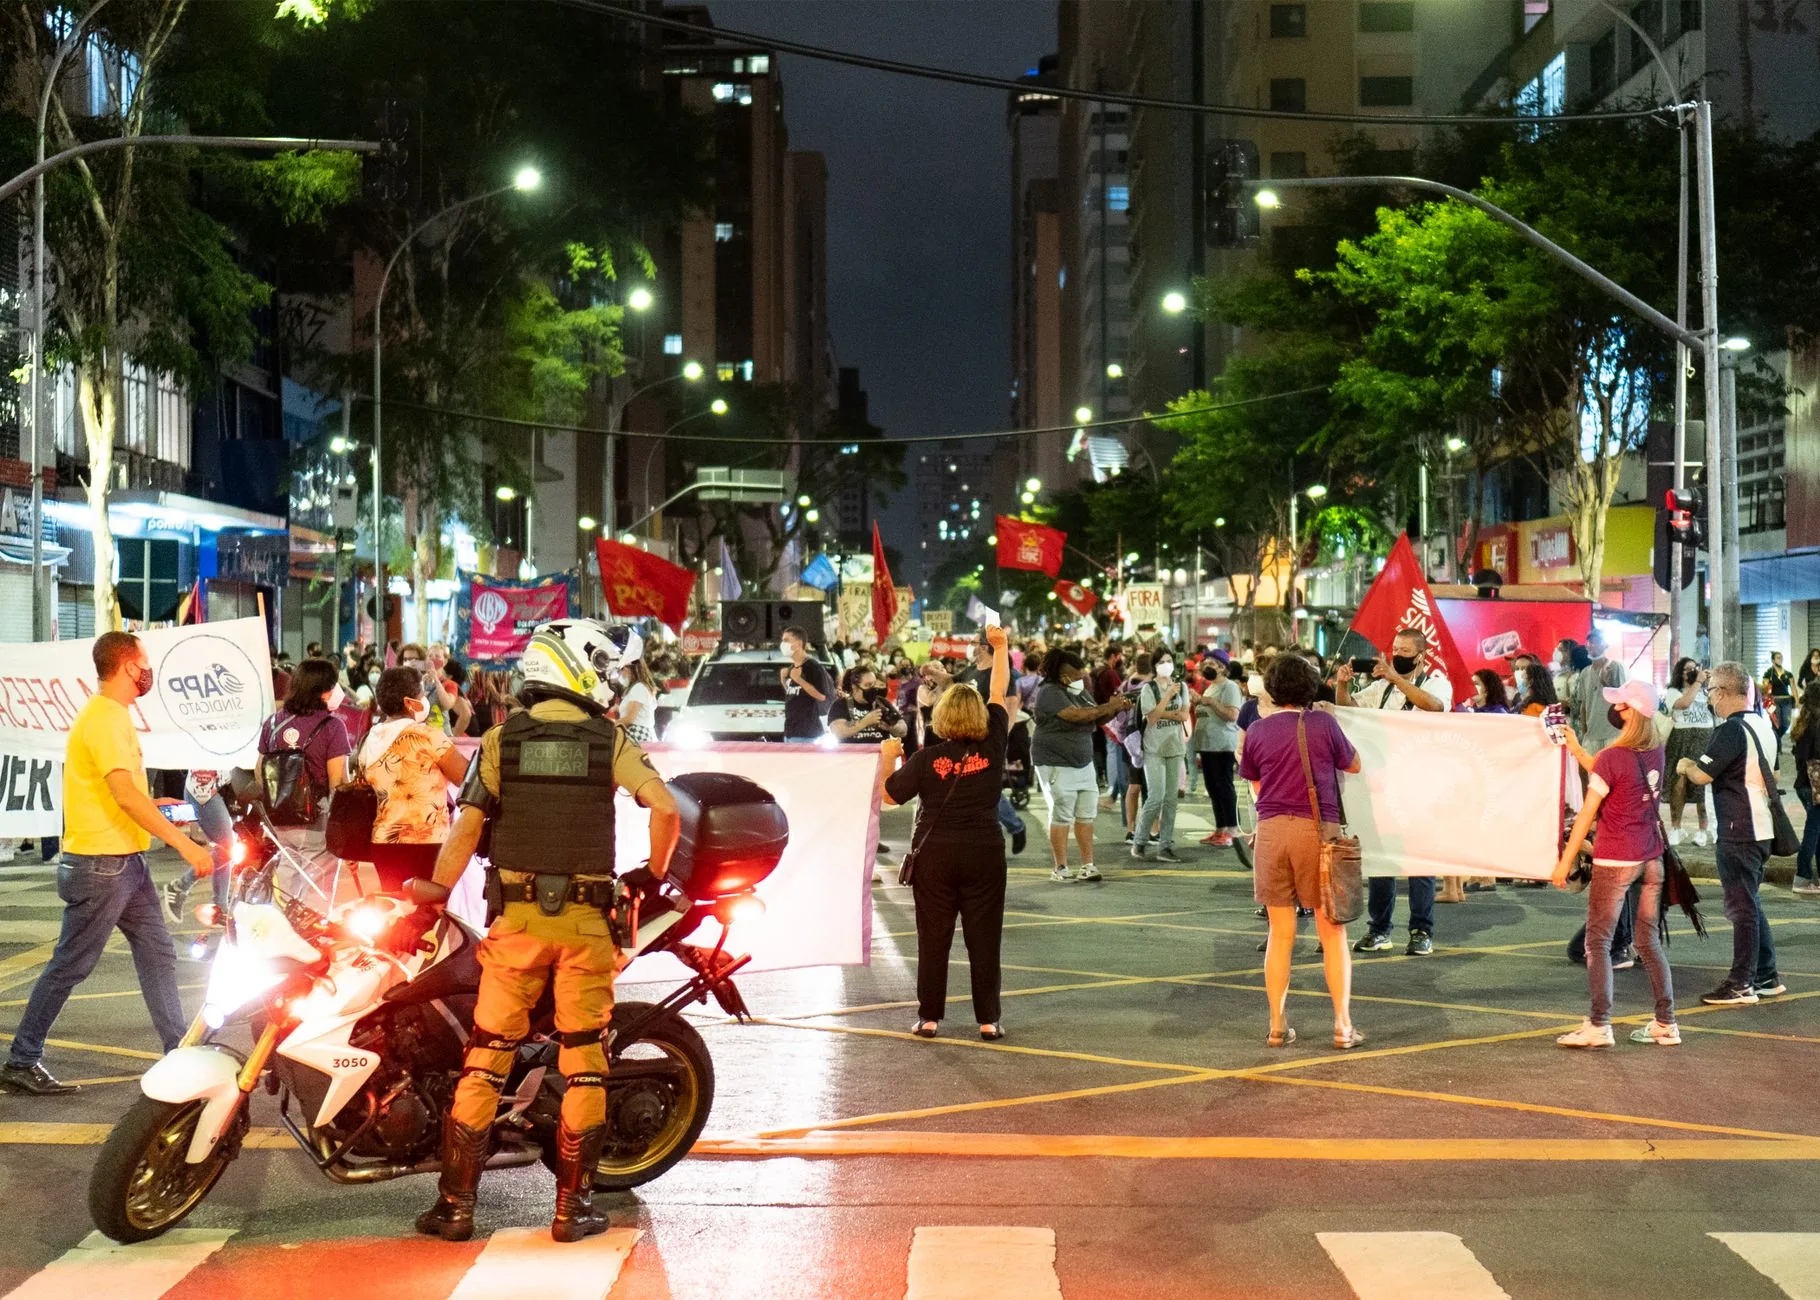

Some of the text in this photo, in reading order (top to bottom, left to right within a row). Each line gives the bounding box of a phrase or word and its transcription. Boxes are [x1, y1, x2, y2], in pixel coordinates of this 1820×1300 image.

[1130, 591, 1161, 607] FORA
[524, 761, 584, 773] MILITAR
[333, 1057, 368, 1069] 3050
